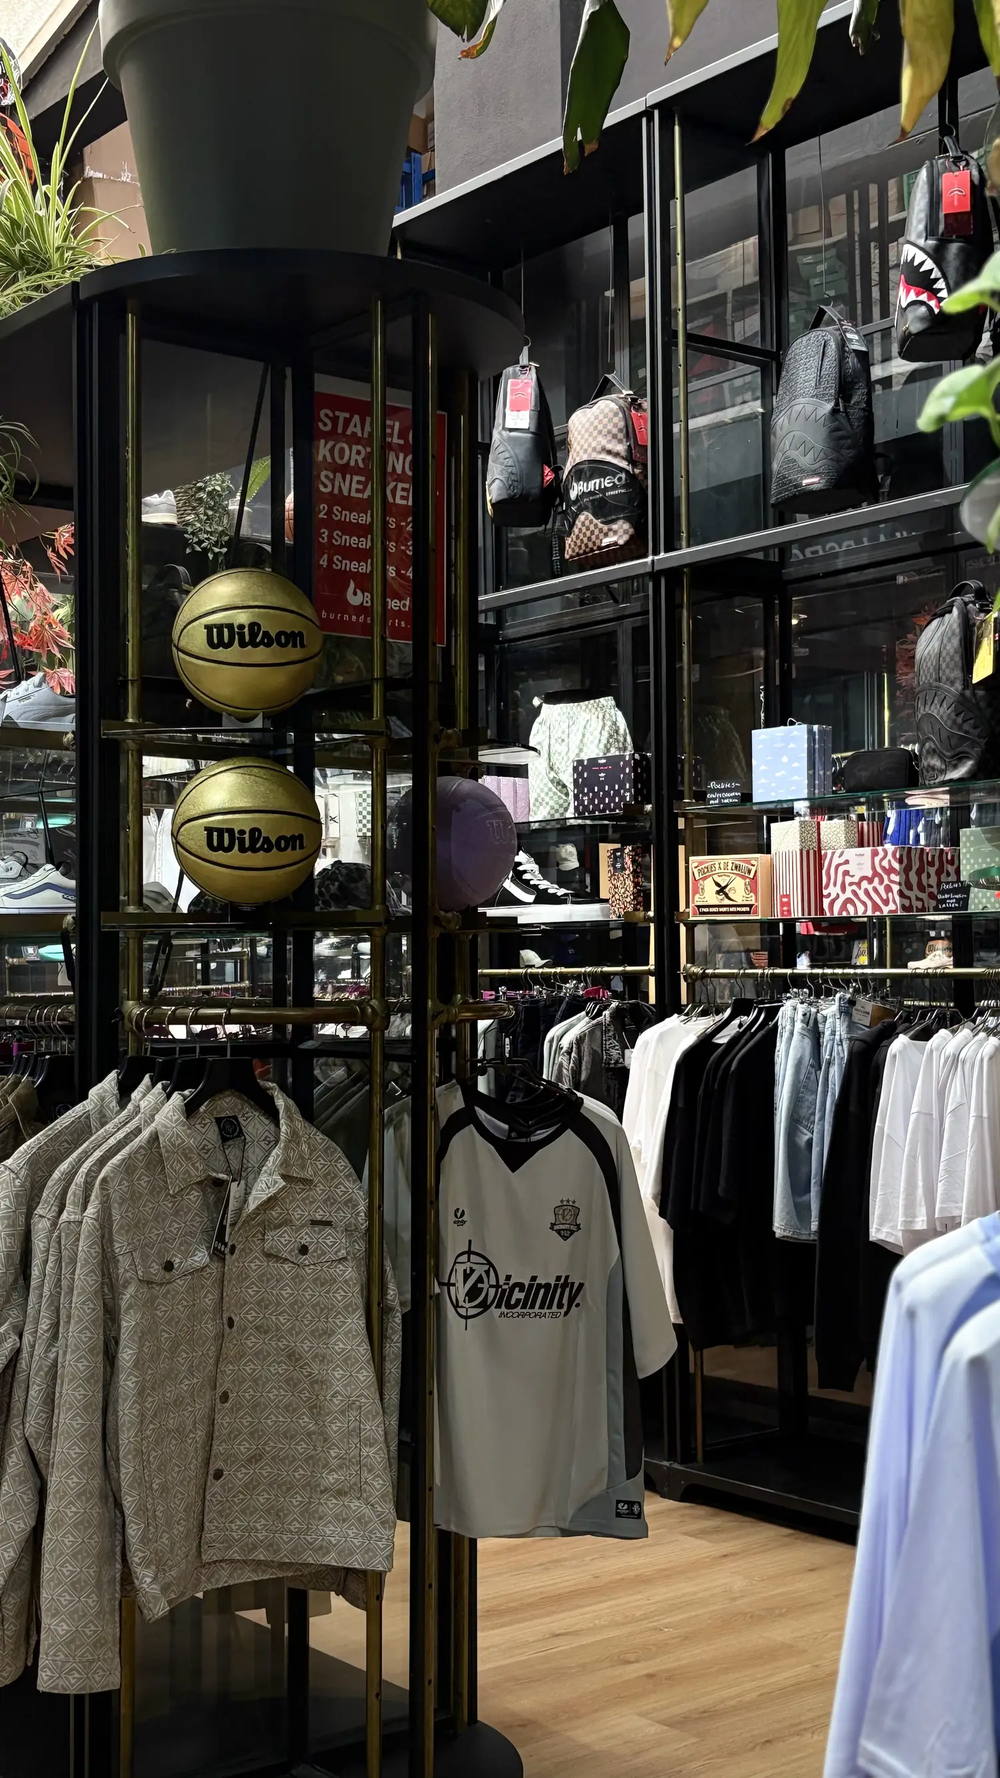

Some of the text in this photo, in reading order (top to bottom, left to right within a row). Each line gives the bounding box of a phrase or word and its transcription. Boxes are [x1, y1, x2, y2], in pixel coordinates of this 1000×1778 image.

[317, 439, 413, 476] KORN
[319, 504, 328, 519] 2
[332, 506, 396, 529] Sneas
[319, 528, 328, 543] 3
[332, 531, 396, 553] Sneas
[319, 553, 328, 568] 4
[332, 555, 396, 578] Sneas
[363, 592, 410, 611] Bned
[204, 621, 306, 650] Wilson
[204, 826, 305, 853] Wilson
[498, 1311, 562, 1319] INCORPORATED
